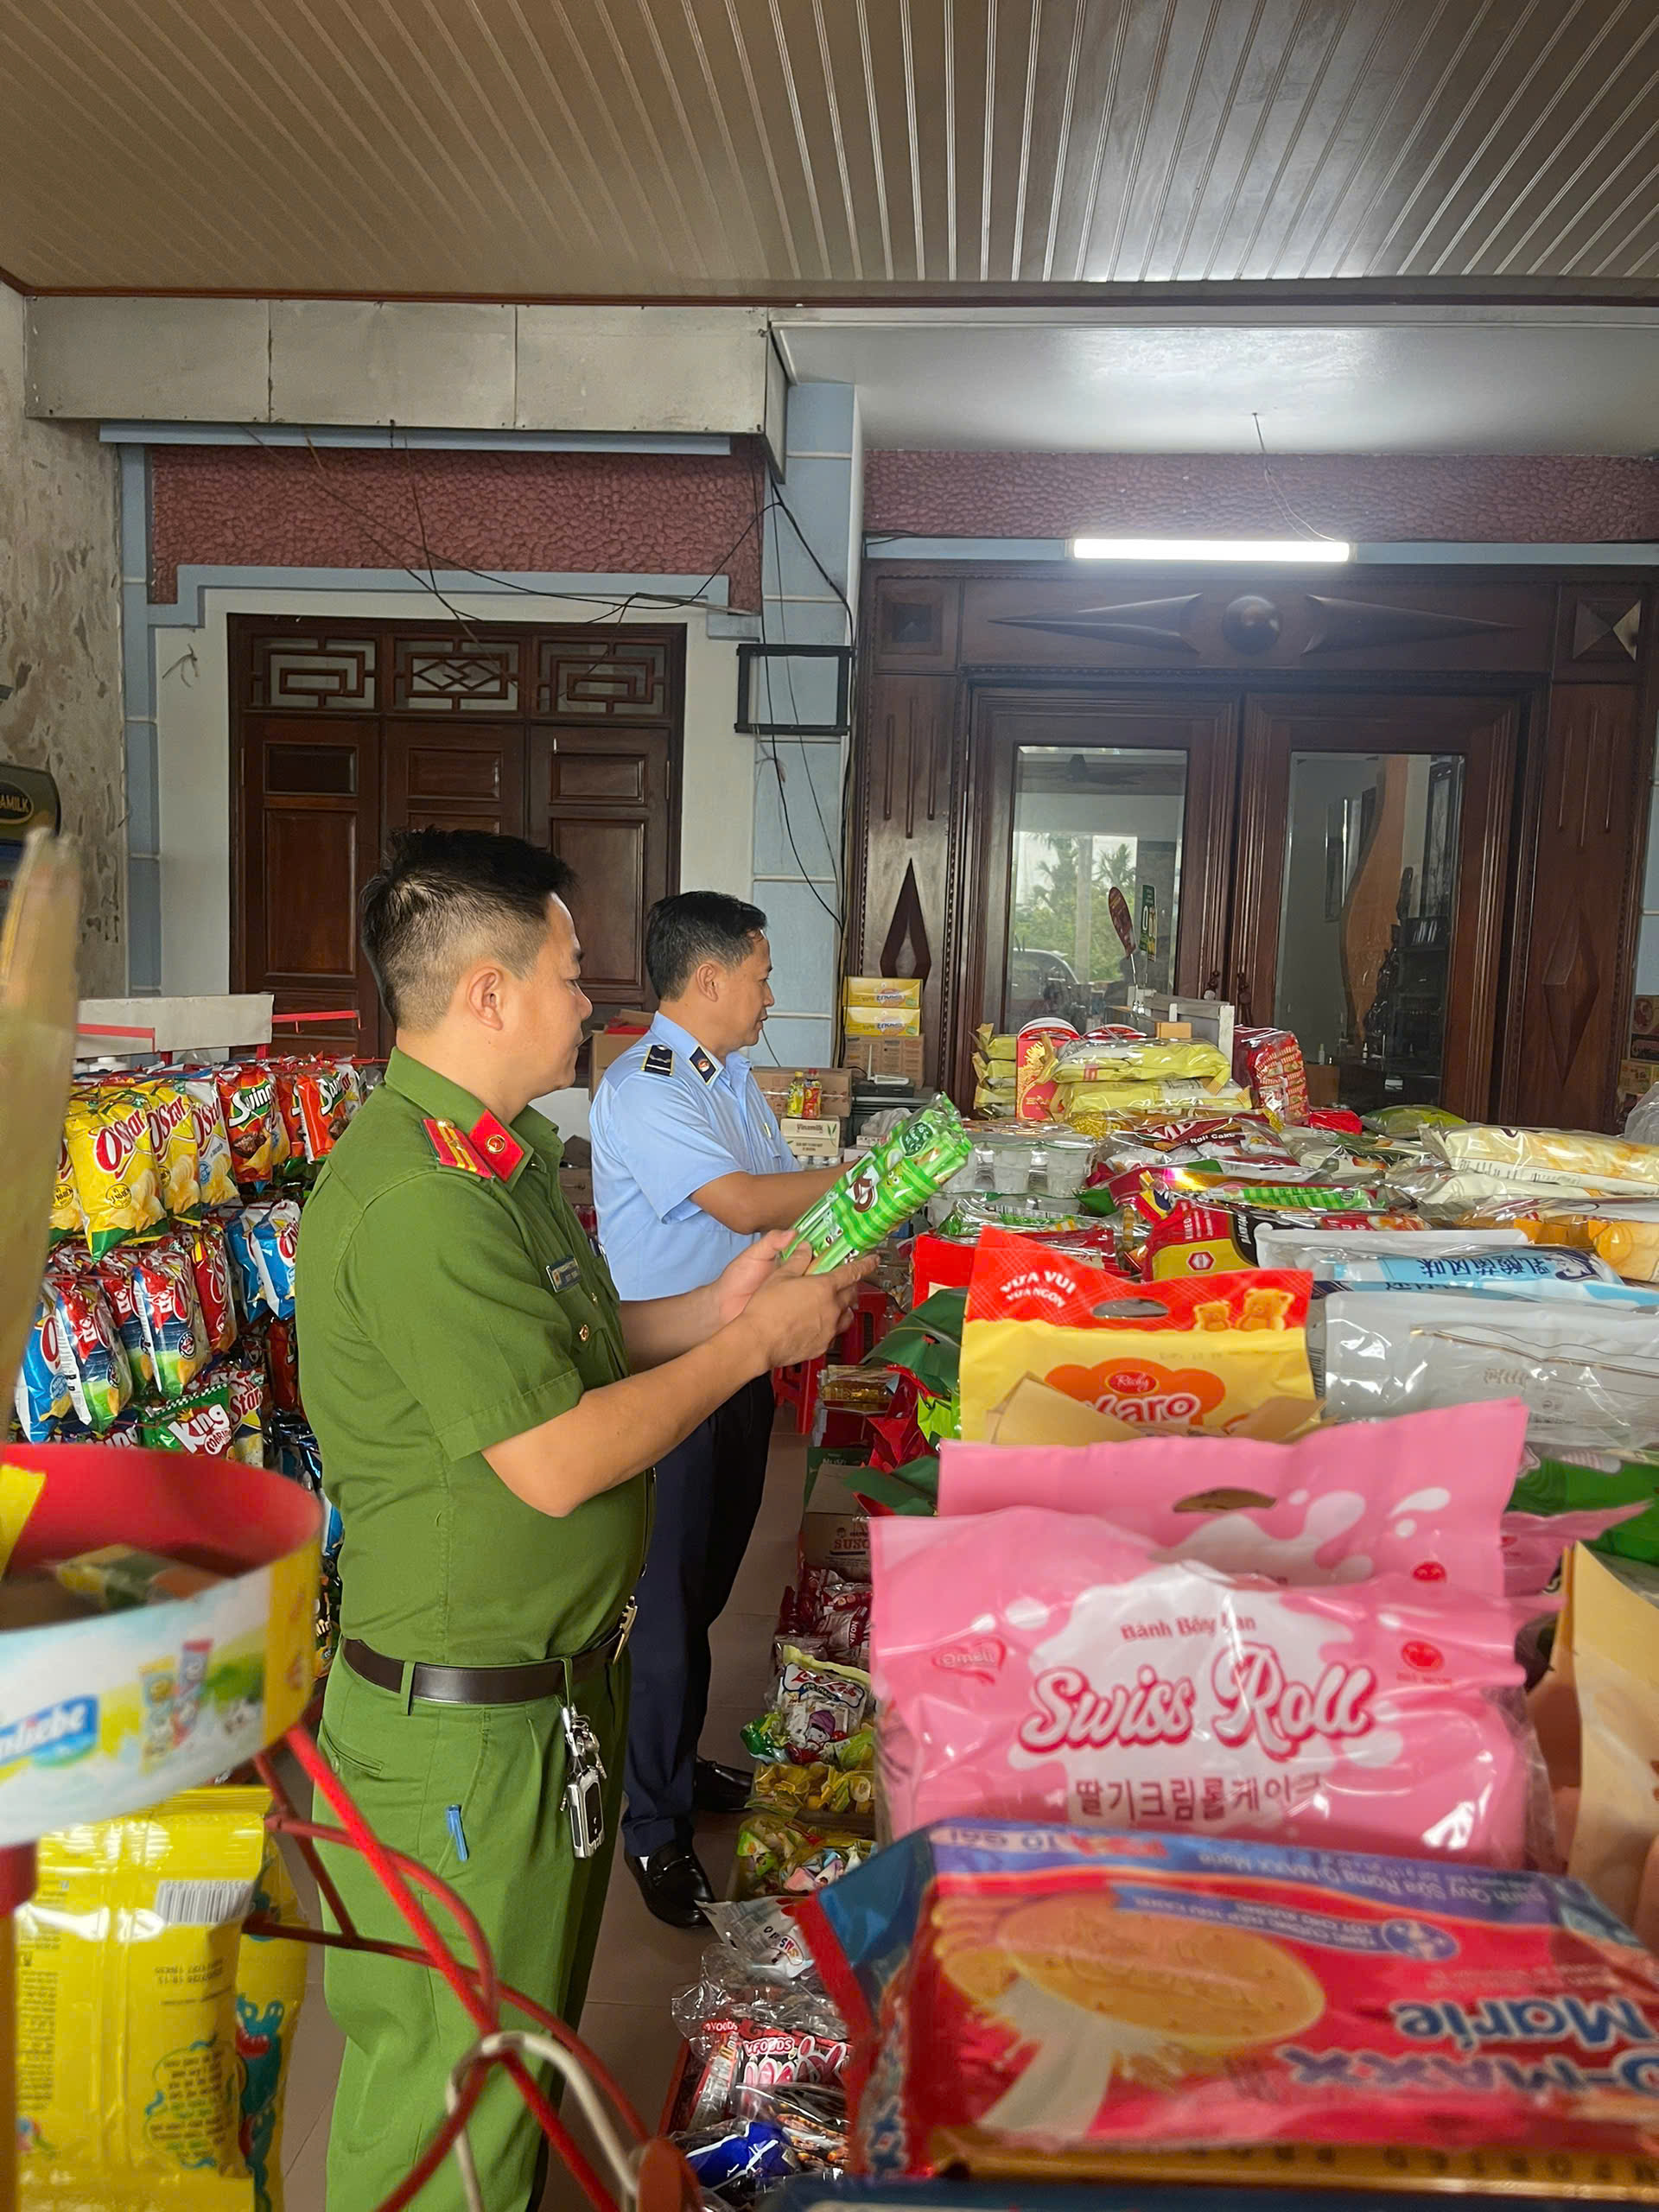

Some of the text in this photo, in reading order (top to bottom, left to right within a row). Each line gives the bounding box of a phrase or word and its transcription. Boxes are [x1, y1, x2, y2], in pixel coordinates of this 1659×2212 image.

[97, 1109, 145, 1172] O'Star
[1189, 1135, 1209, 1144] Roll
[1044, 1269, 1077, 1294] VUI
[1033, 1287, 1066, 1308] NGON
[167, 1403, 231, 1454] King
[1120, 1618, 1173, 1641] Bánh
[1018, 1641, 1376, 1763] Swiss Roll
[1391, 1994, 1658, 2052] Marie
[744, 2037, 794, 2056] VFOODS
